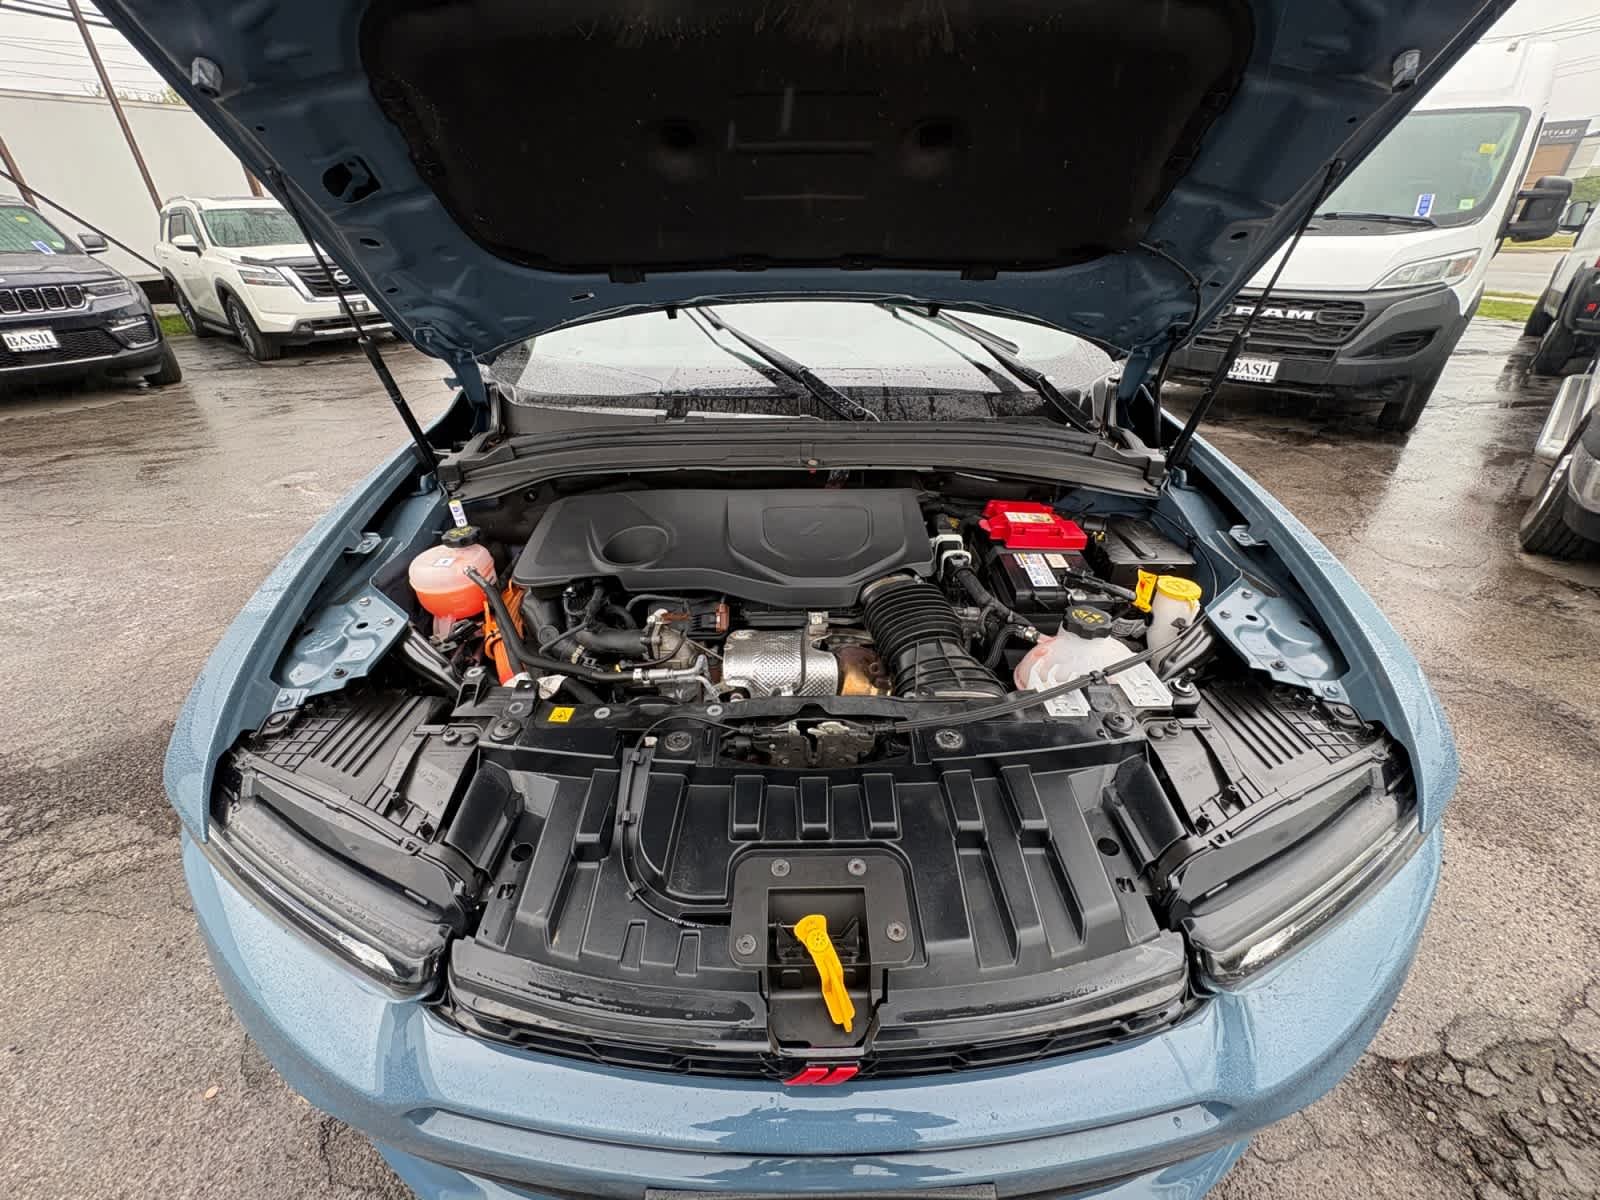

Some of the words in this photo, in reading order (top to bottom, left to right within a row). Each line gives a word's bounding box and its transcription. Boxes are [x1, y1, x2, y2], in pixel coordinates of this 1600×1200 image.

[1234, 306, 1314, 320] RAM
[7, 332, 55, 347] BASIL
[1232, 361, 1274, 377] BASIL
